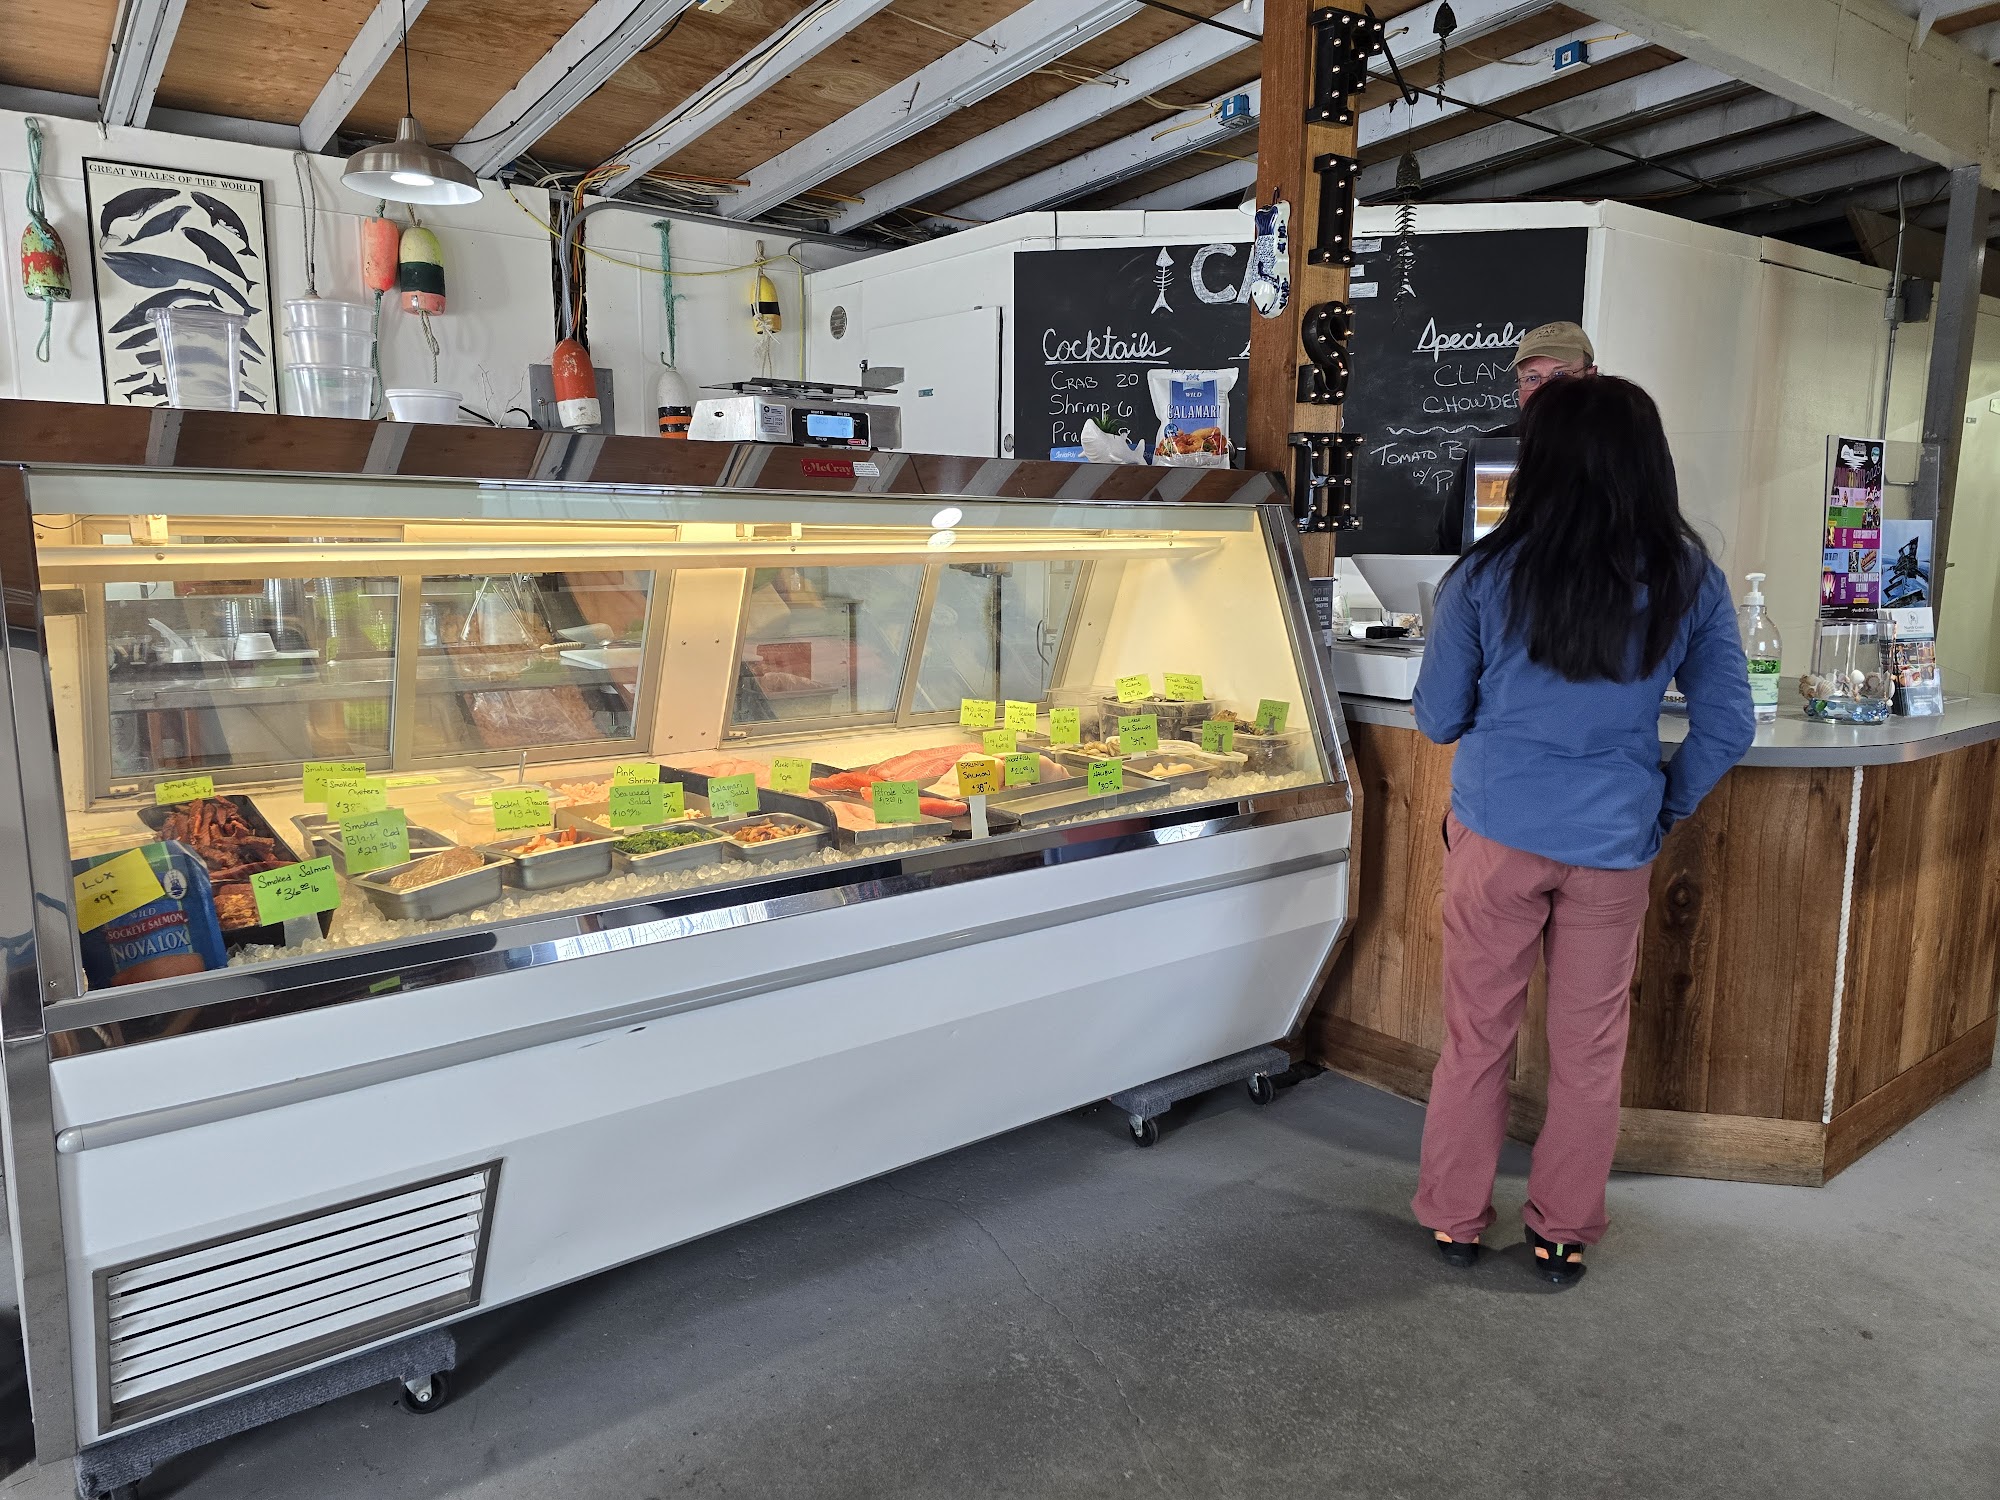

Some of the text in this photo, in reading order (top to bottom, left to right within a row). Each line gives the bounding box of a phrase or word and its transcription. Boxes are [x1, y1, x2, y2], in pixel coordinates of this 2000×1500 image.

[89, 163, 257, 193] GREAT WHALES OF THE WORLD
[1190, 238, 1382, 304] CE
[1289, 7, 1385, 533] FISH
[1043, 326, 1172, 361] Cocktails
[1417, 316, 1526, 362] Specials
[1116, 374, 1139, 388] 20
[1049, 394, 1110, 420] Shrimp
[1166, 404, 1221, 419] CALAMARI
[1053, 421, 1079, 443] Pra
[803, 462, 851, 475] McCray
[1489, 480, 1509, 499] FI
[628, 777, 658, 785] Shrimp
[711, 780, 743, 793] Calamari
[344, 818, 379, 832] Smoked
[383, 827, 400, 838] Cod
[258, 864, 331, 889] Smoked Salmon
[130, 907, 156, 919] WILD
[107, 912, 184, 940] SOCKEYE SALMON
[112, 929, 191, 963] NOVA LOX
